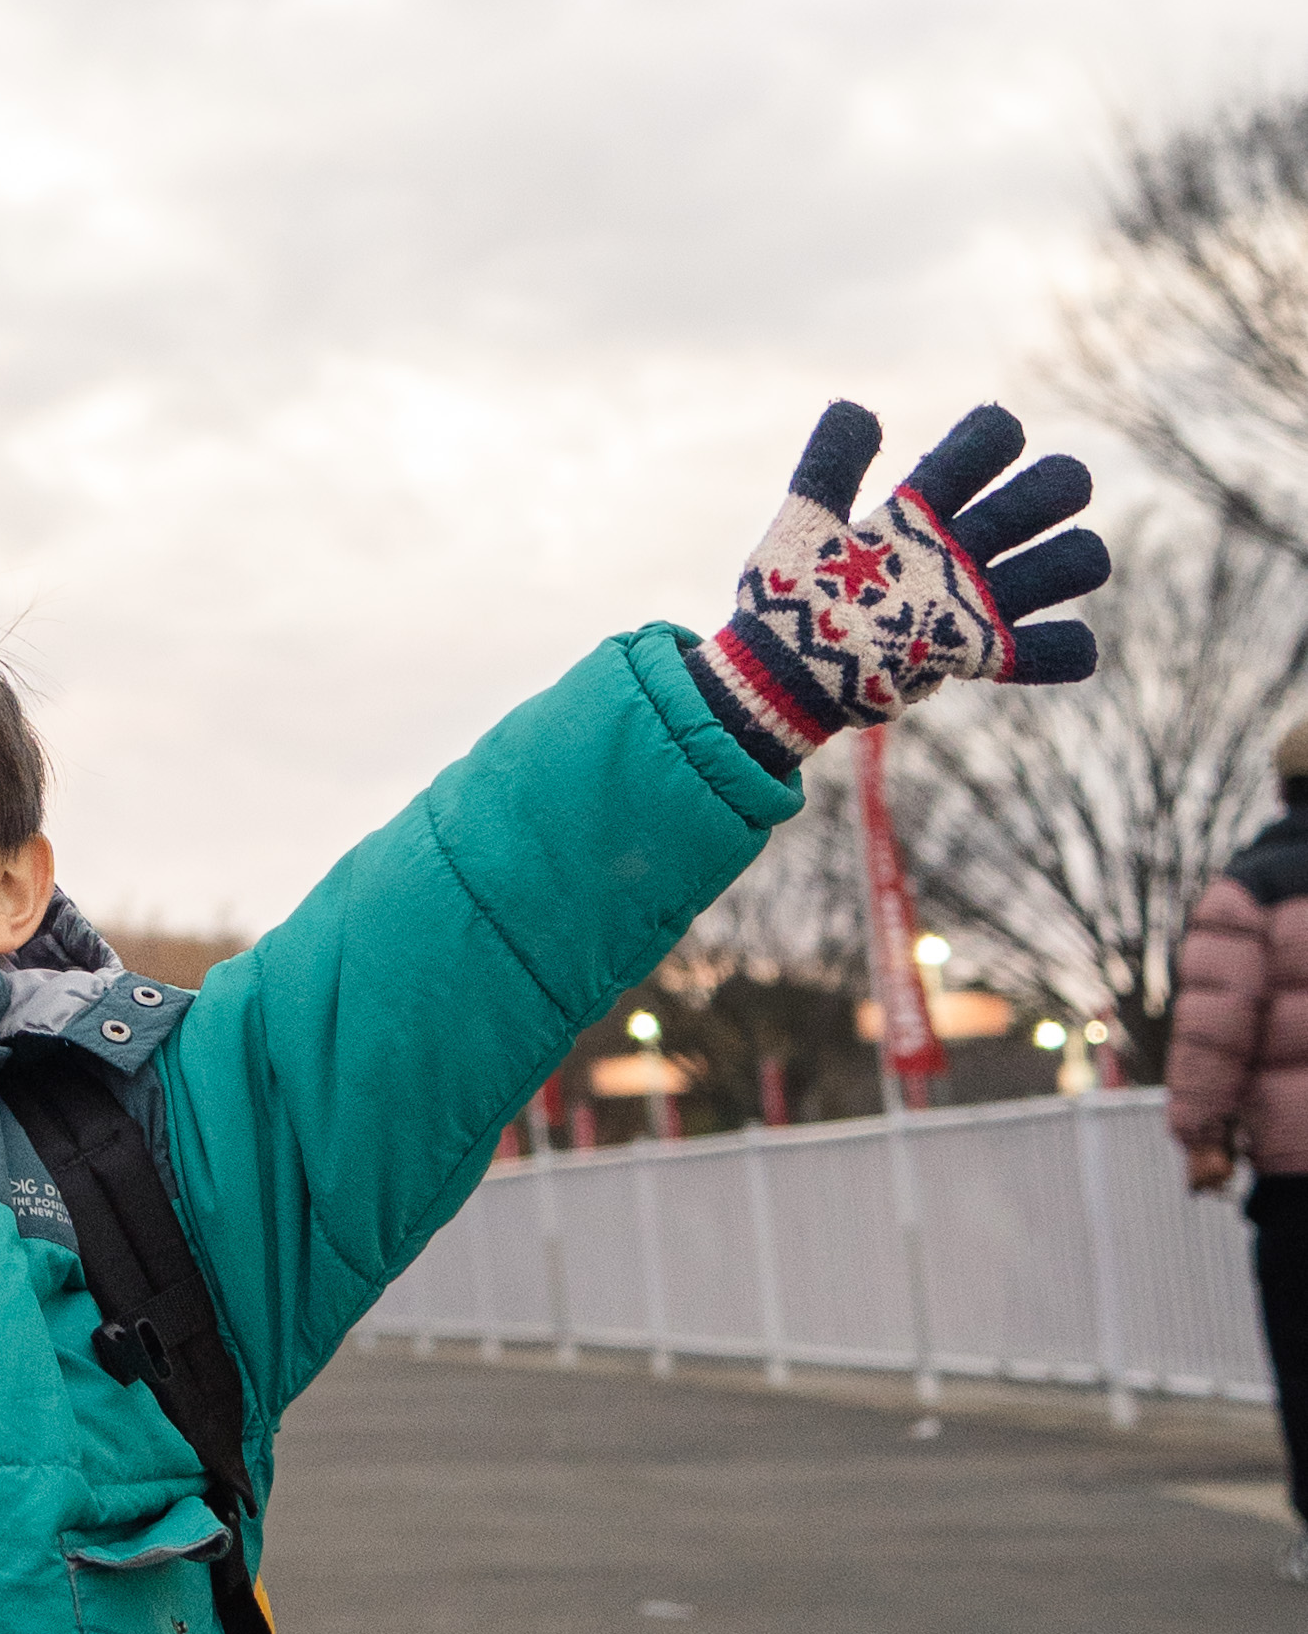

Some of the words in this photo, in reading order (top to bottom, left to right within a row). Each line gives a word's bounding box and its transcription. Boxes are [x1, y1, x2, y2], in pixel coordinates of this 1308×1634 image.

[12, 1196, 32, 1206] THE
[18, 1207, 27, 1217] A
[29, 1206, 54, 1218] NEW
